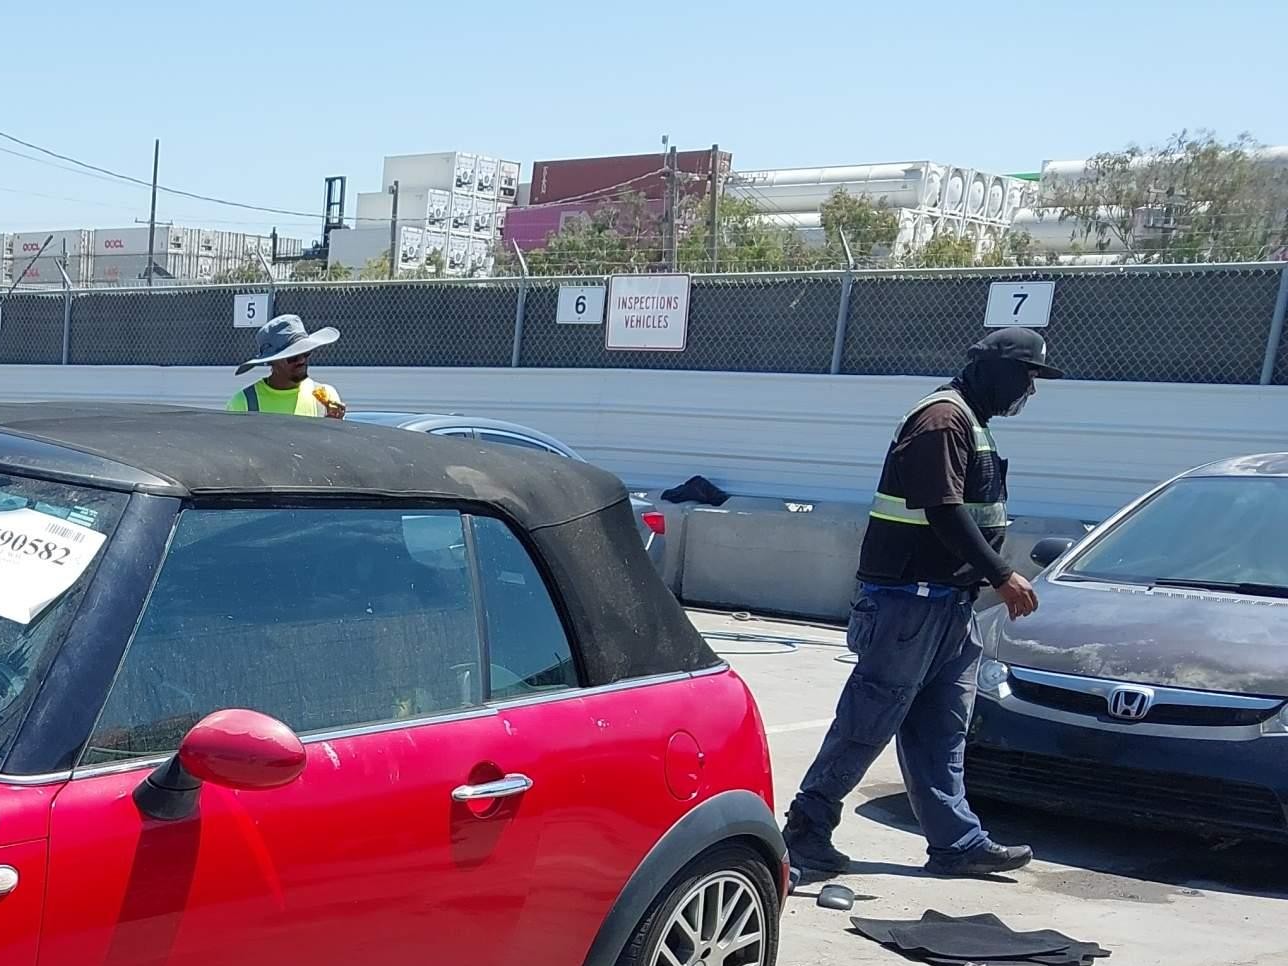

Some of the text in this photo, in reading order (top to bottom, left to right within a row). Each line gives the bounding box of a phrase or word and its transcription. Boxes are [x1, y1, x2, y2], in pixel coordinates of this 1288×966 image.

[247, 302, 256, 319] 5
[575, 296, 586, 314] 6
[617, 296, 679, 310] INSPECTIONS
[1013, 294, 1028, 315] 7
[624, 315, 669, 329] VEHICLES
